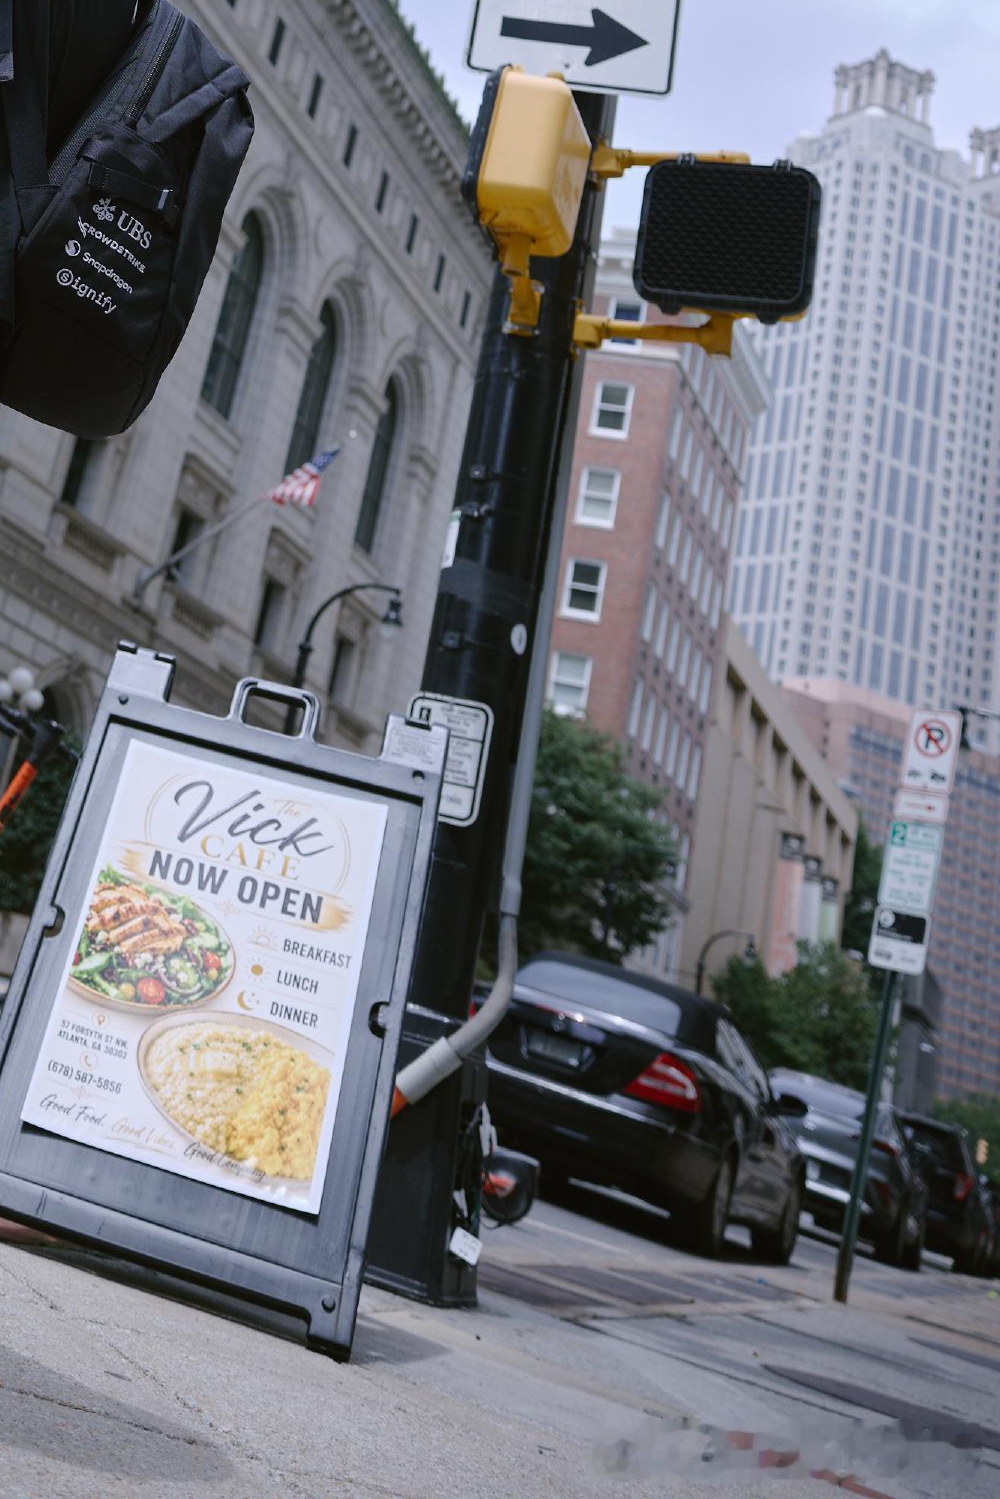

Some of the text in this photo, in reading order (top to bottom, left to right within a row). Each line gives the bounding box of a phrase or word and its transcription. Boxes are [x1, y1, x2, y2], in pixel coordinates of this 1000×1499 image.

[83, 222, 146, 274] CROWDSTRIKE
[117, 210, 152, 249] UBS
[82, 252, 133, 294] Snapdragon
[174, 780, 334, 857] Vick
[200, 835, 300, 881] CAFE
[149, 850, 324, 924] NOW OPEN
[283, 938, 352, 969] BREAKFAST
[277, 969, 319, 994] LUNCH
[72, 1023, 102, 1040] FORSYTH
[270, 1001, 318, 1028] DINNER
[91, 1041, 101, 1051] GA
[47, 1059, 122, 1094] (678) 587-5856
[39, 1093, 77, 1116] Good
[183, 1141, 219, 1164] Good
